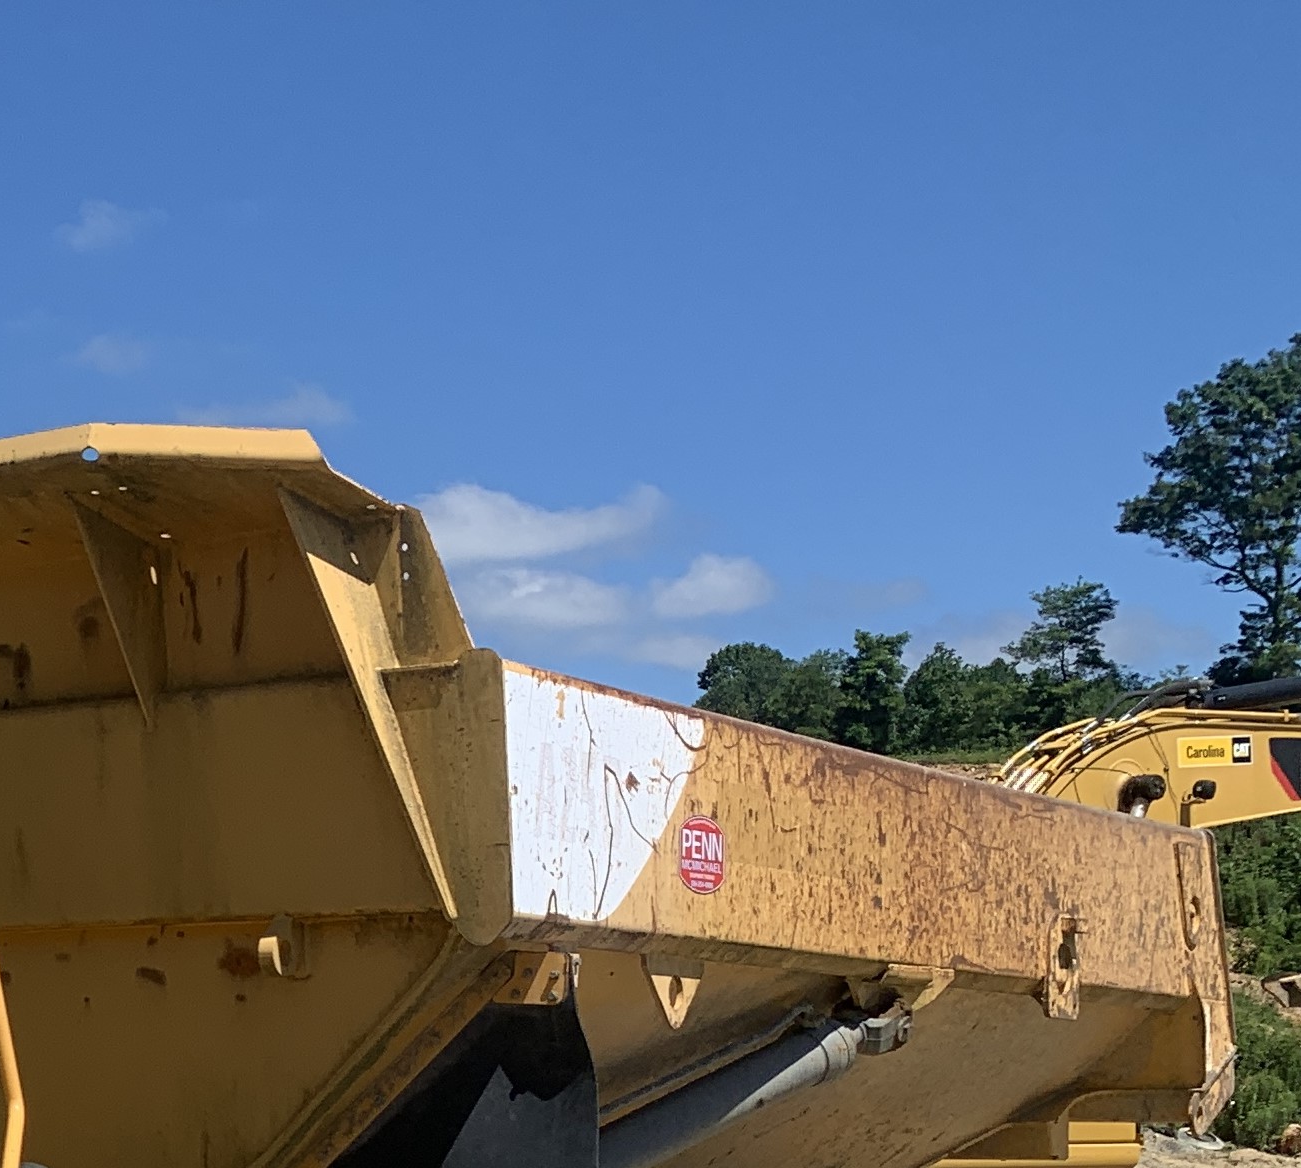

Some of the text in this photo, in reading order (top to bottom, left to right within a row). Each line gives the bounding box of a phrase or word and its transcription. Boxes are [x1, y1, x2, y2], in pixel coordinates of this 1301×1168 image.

[1186, 743, 1251, 759] Carolina CAT
[682, 828, 723, 863] PENN
